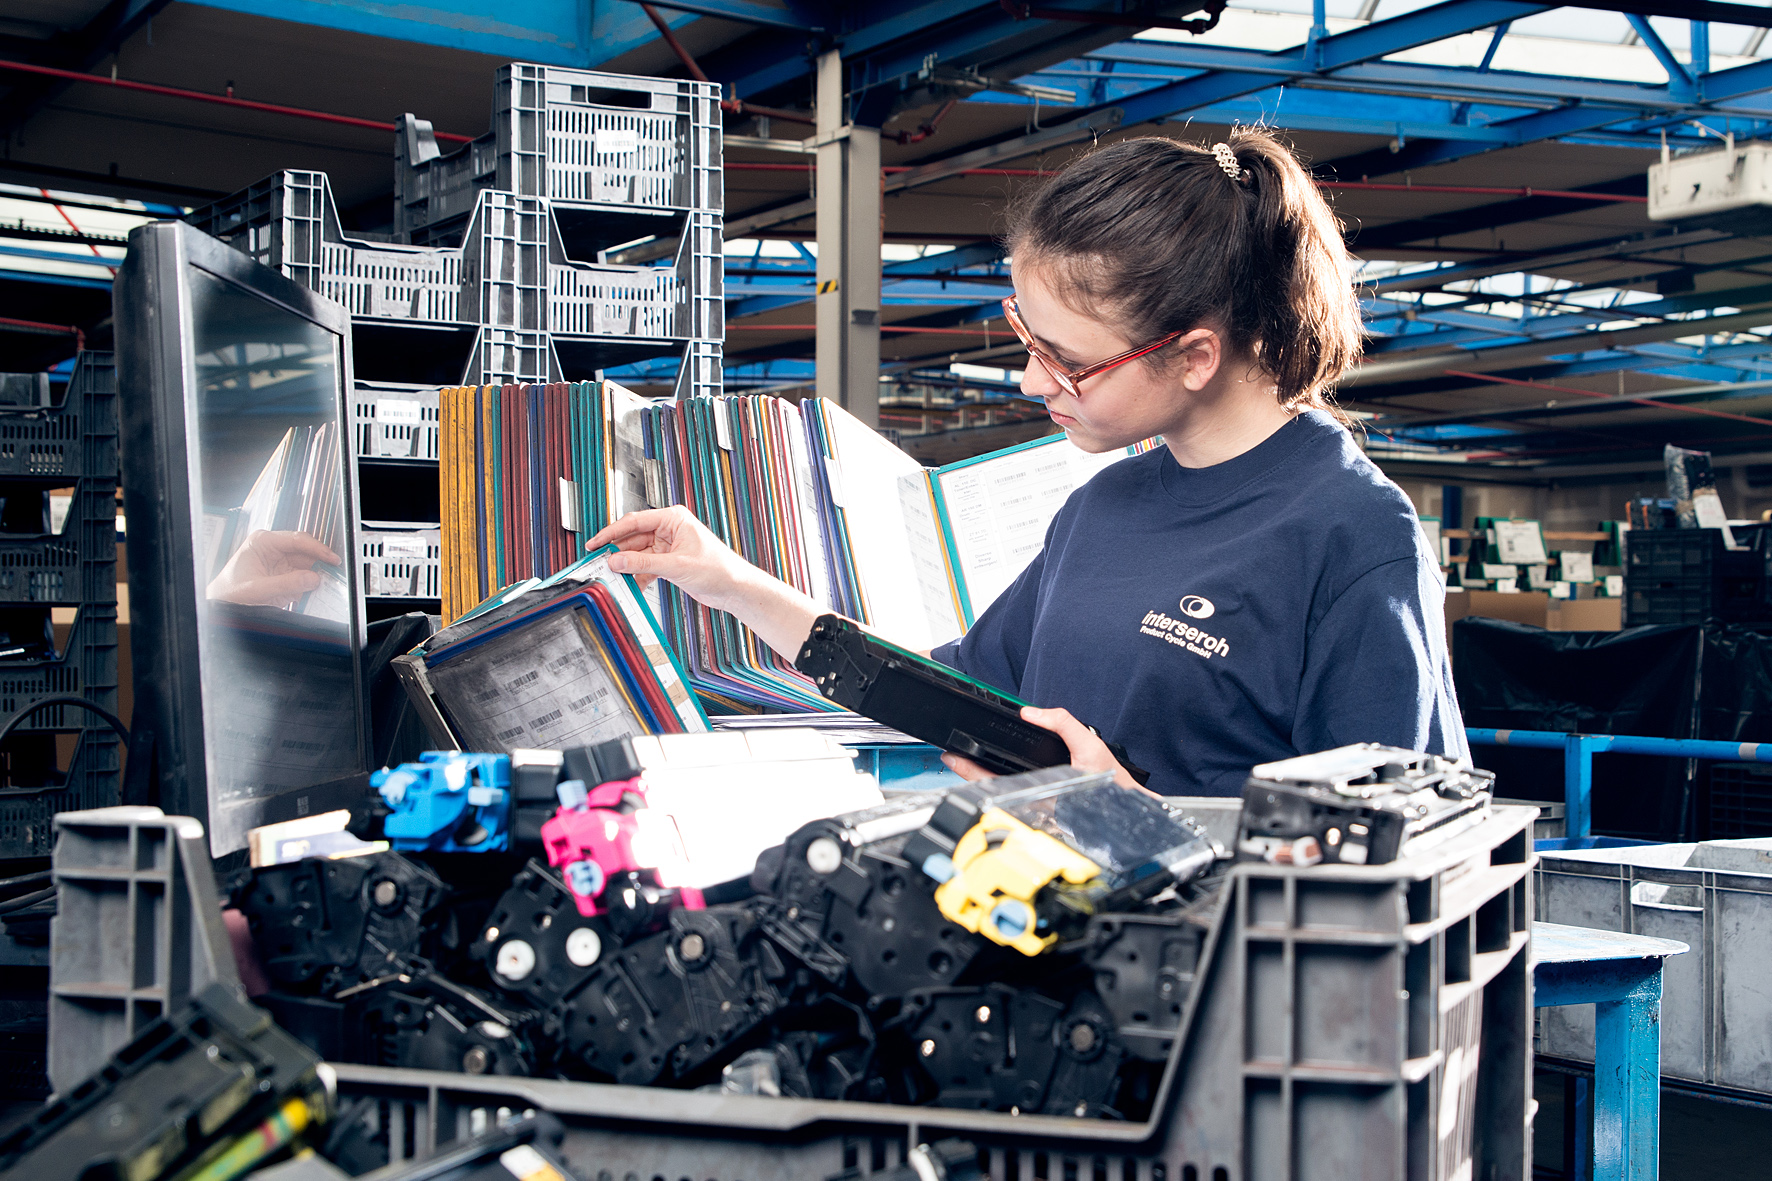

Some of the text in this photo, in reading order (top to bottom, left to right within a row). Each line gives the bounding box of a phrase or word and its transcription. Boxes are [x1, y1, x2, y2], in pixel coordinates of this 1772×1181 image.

[1140, 625, 1213, 659] Product Cycle GmbH
[1141, 610, 1230, 657] interseroh
